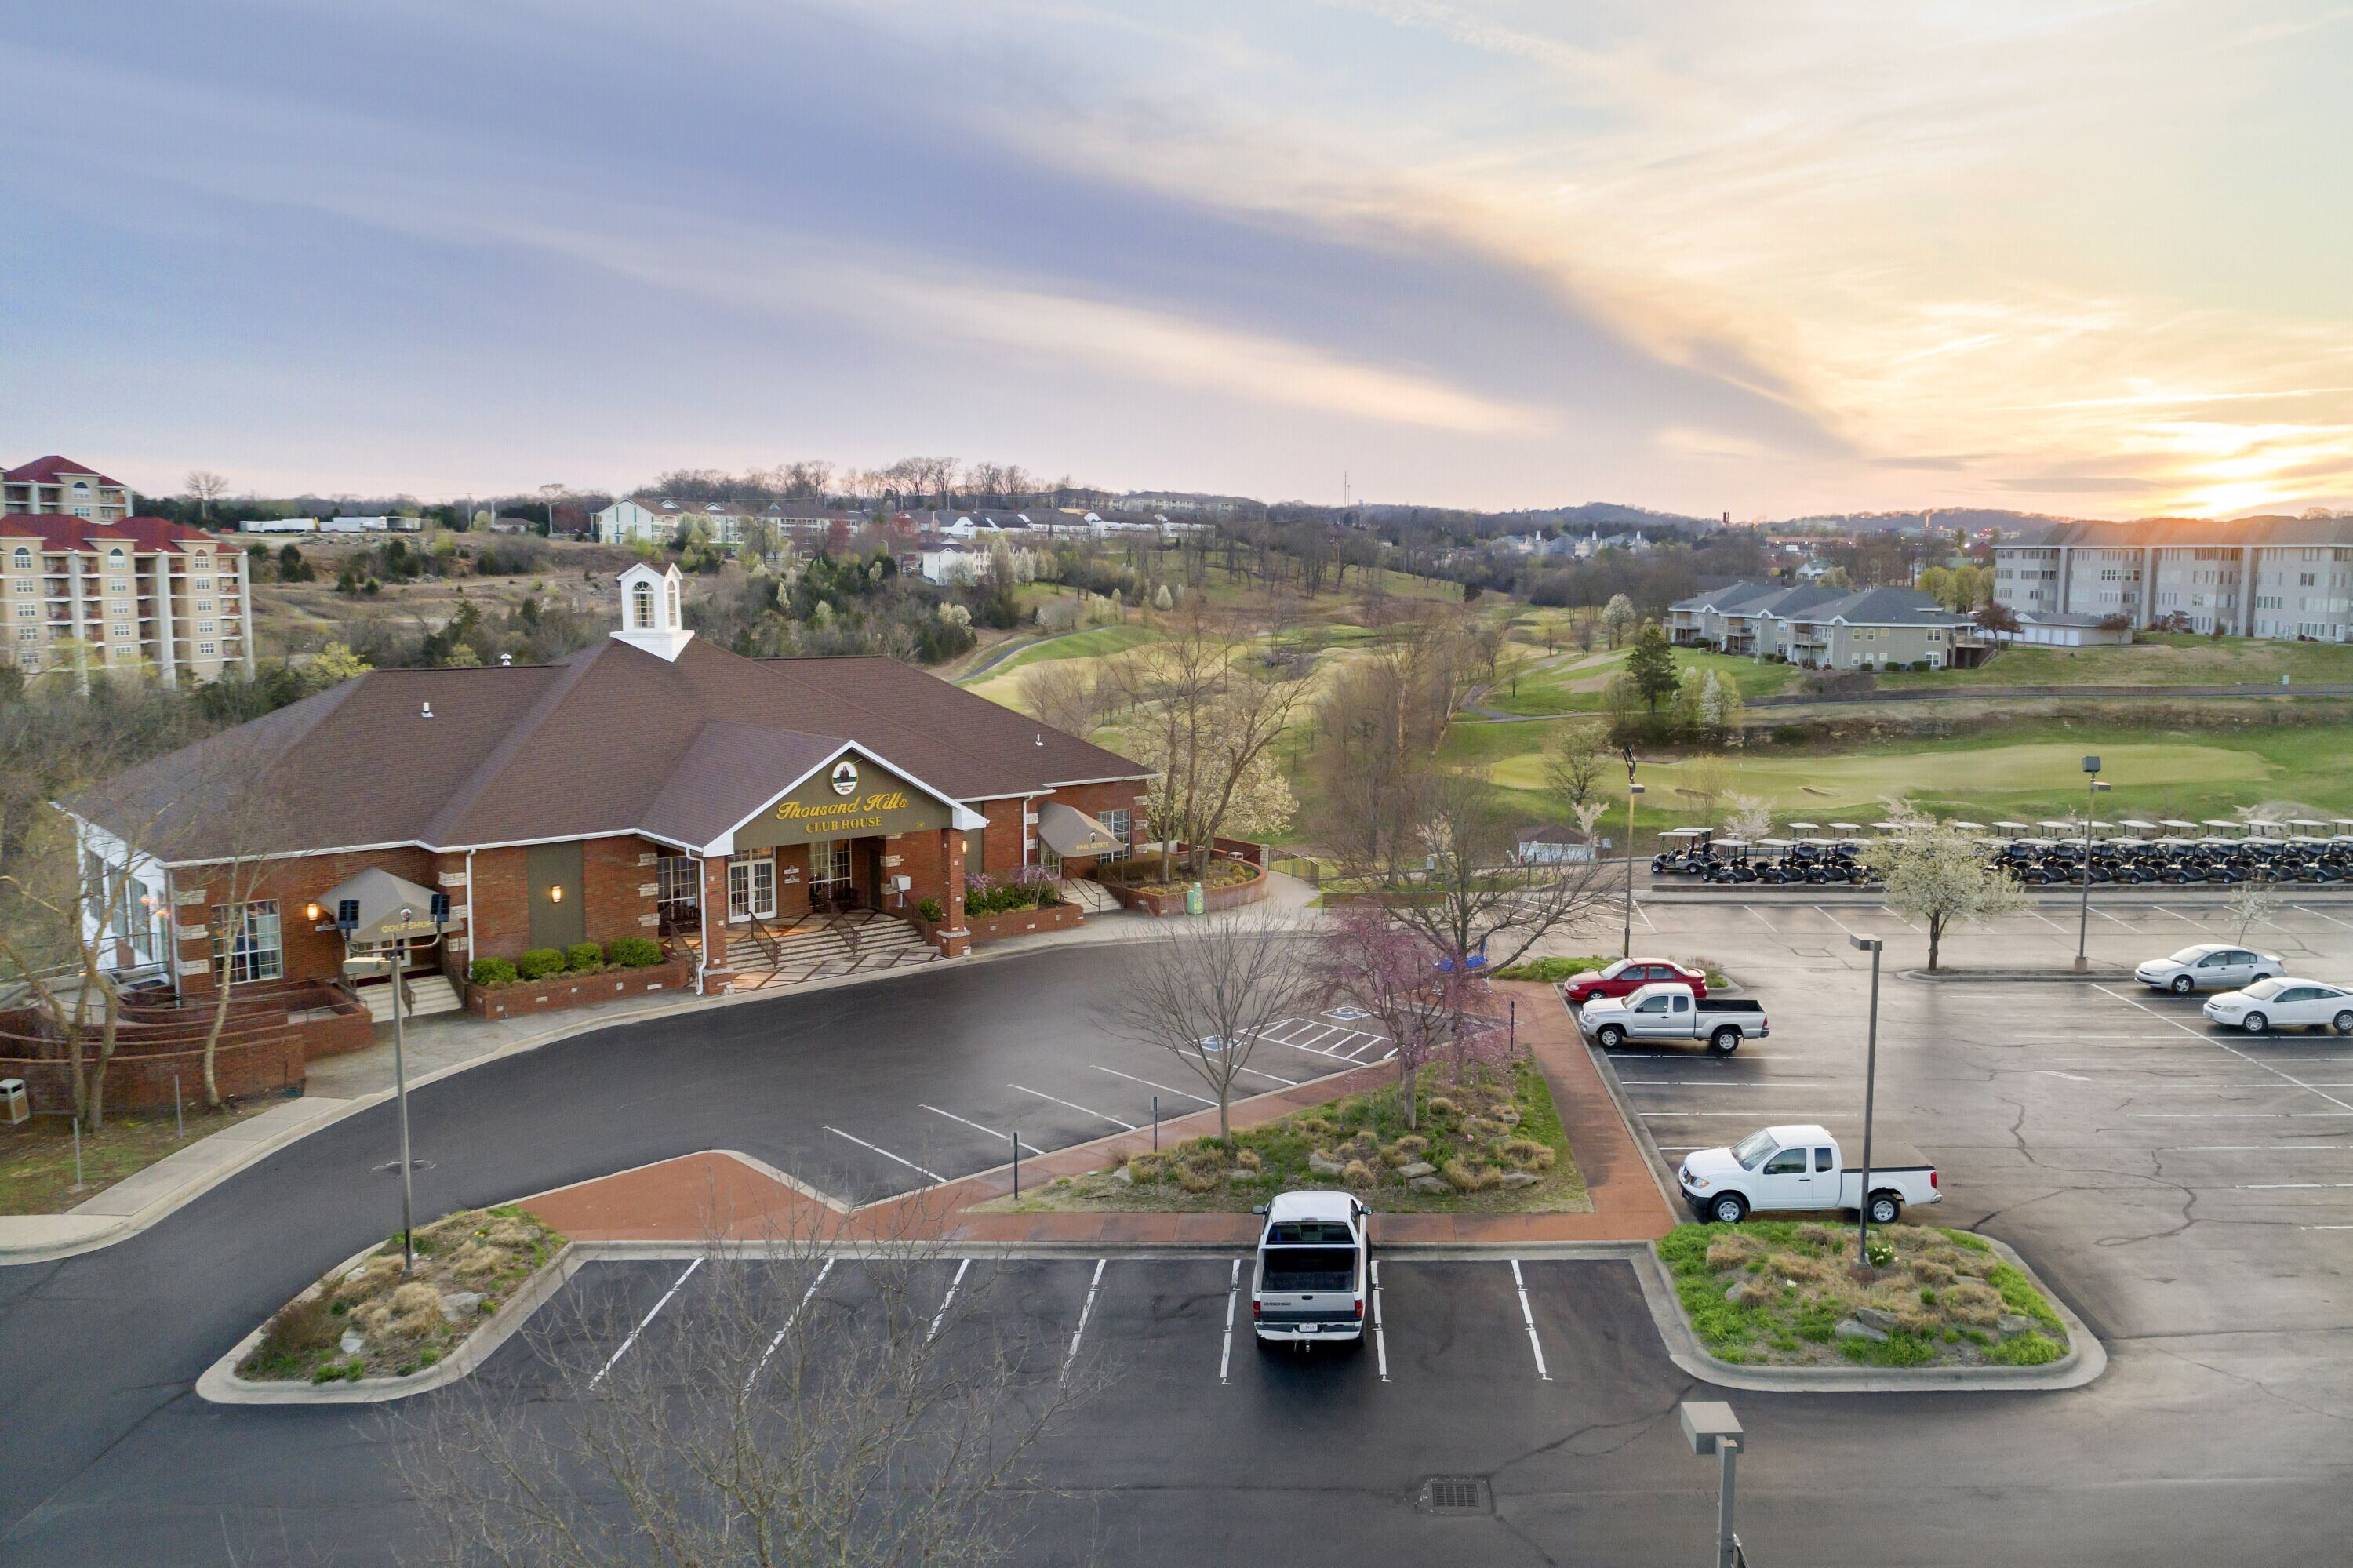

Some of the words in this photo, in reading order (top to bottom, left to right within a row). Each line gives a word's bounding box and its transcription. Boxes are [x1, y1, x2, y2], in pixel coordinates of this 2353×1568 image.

[776, 795, 861, 820] Thousand
[863, 792, 908, 812] Hills
[806, 821, 838, 834] CLUB
[842, 817, 882, 830] HOUSE
[1091, 841, 1109, 849] ESTATE
[381, 922, 406, 933] GOLF
